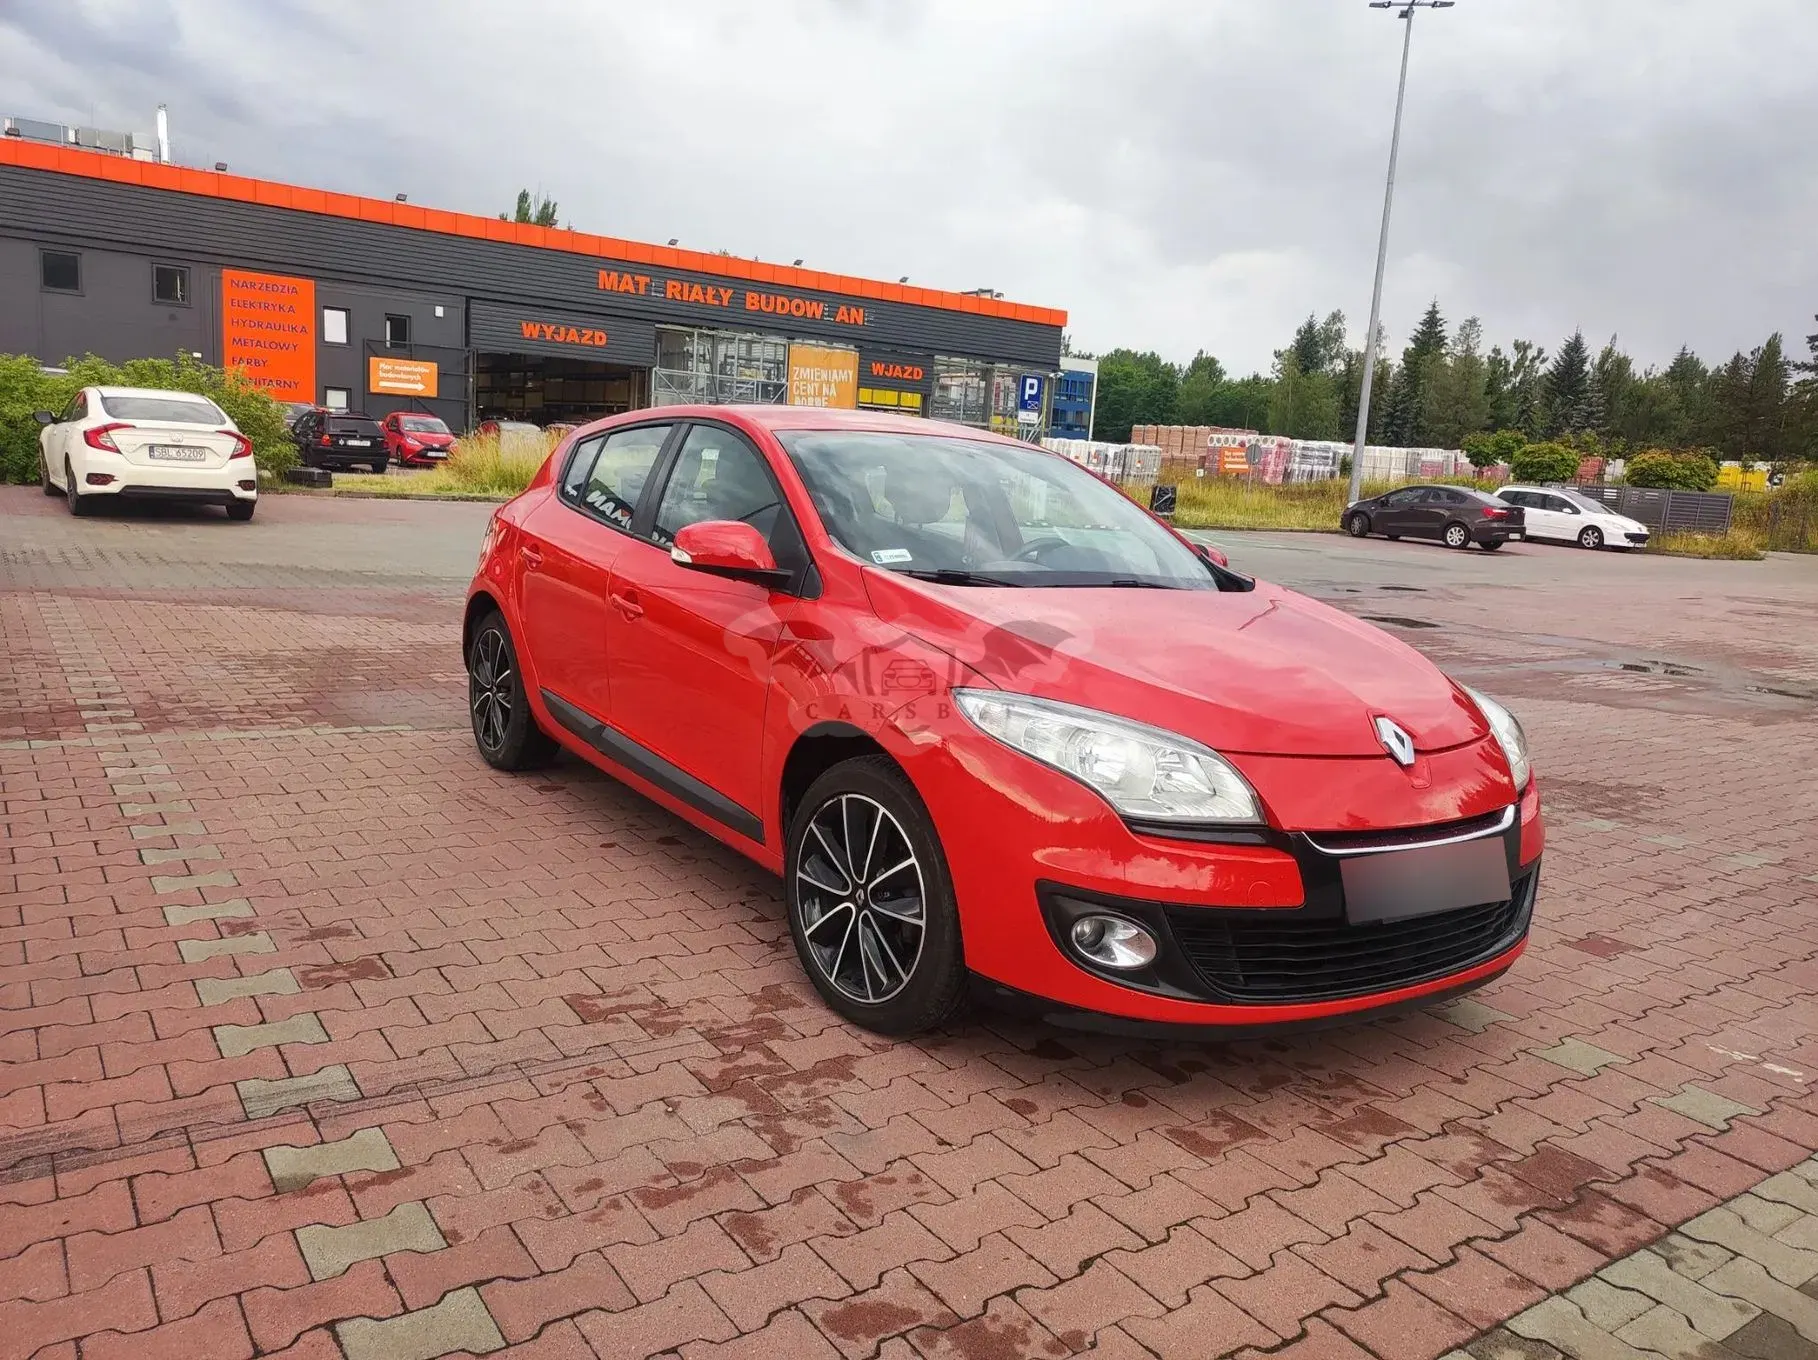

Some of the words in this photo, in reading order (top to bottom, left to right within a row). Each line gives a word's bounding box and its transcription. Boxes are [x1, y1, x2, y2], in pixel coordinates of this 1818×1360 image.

[230, 298, 296, 314] ELEKTRYKA
[231, 317, 309, 335] HYDRAULIKA
[521, 321, 607, 347] WYJAZD
[232, 337, 299, 353] METALOWY
[231, 356, 268, 367] FARBY
[793, 366, 853, 383] ZMIENIAMY
[872, 362, 923, 381] WJAZD
[822, 382, 837, 398] NA
[1024, 377, 1038, 400] P
